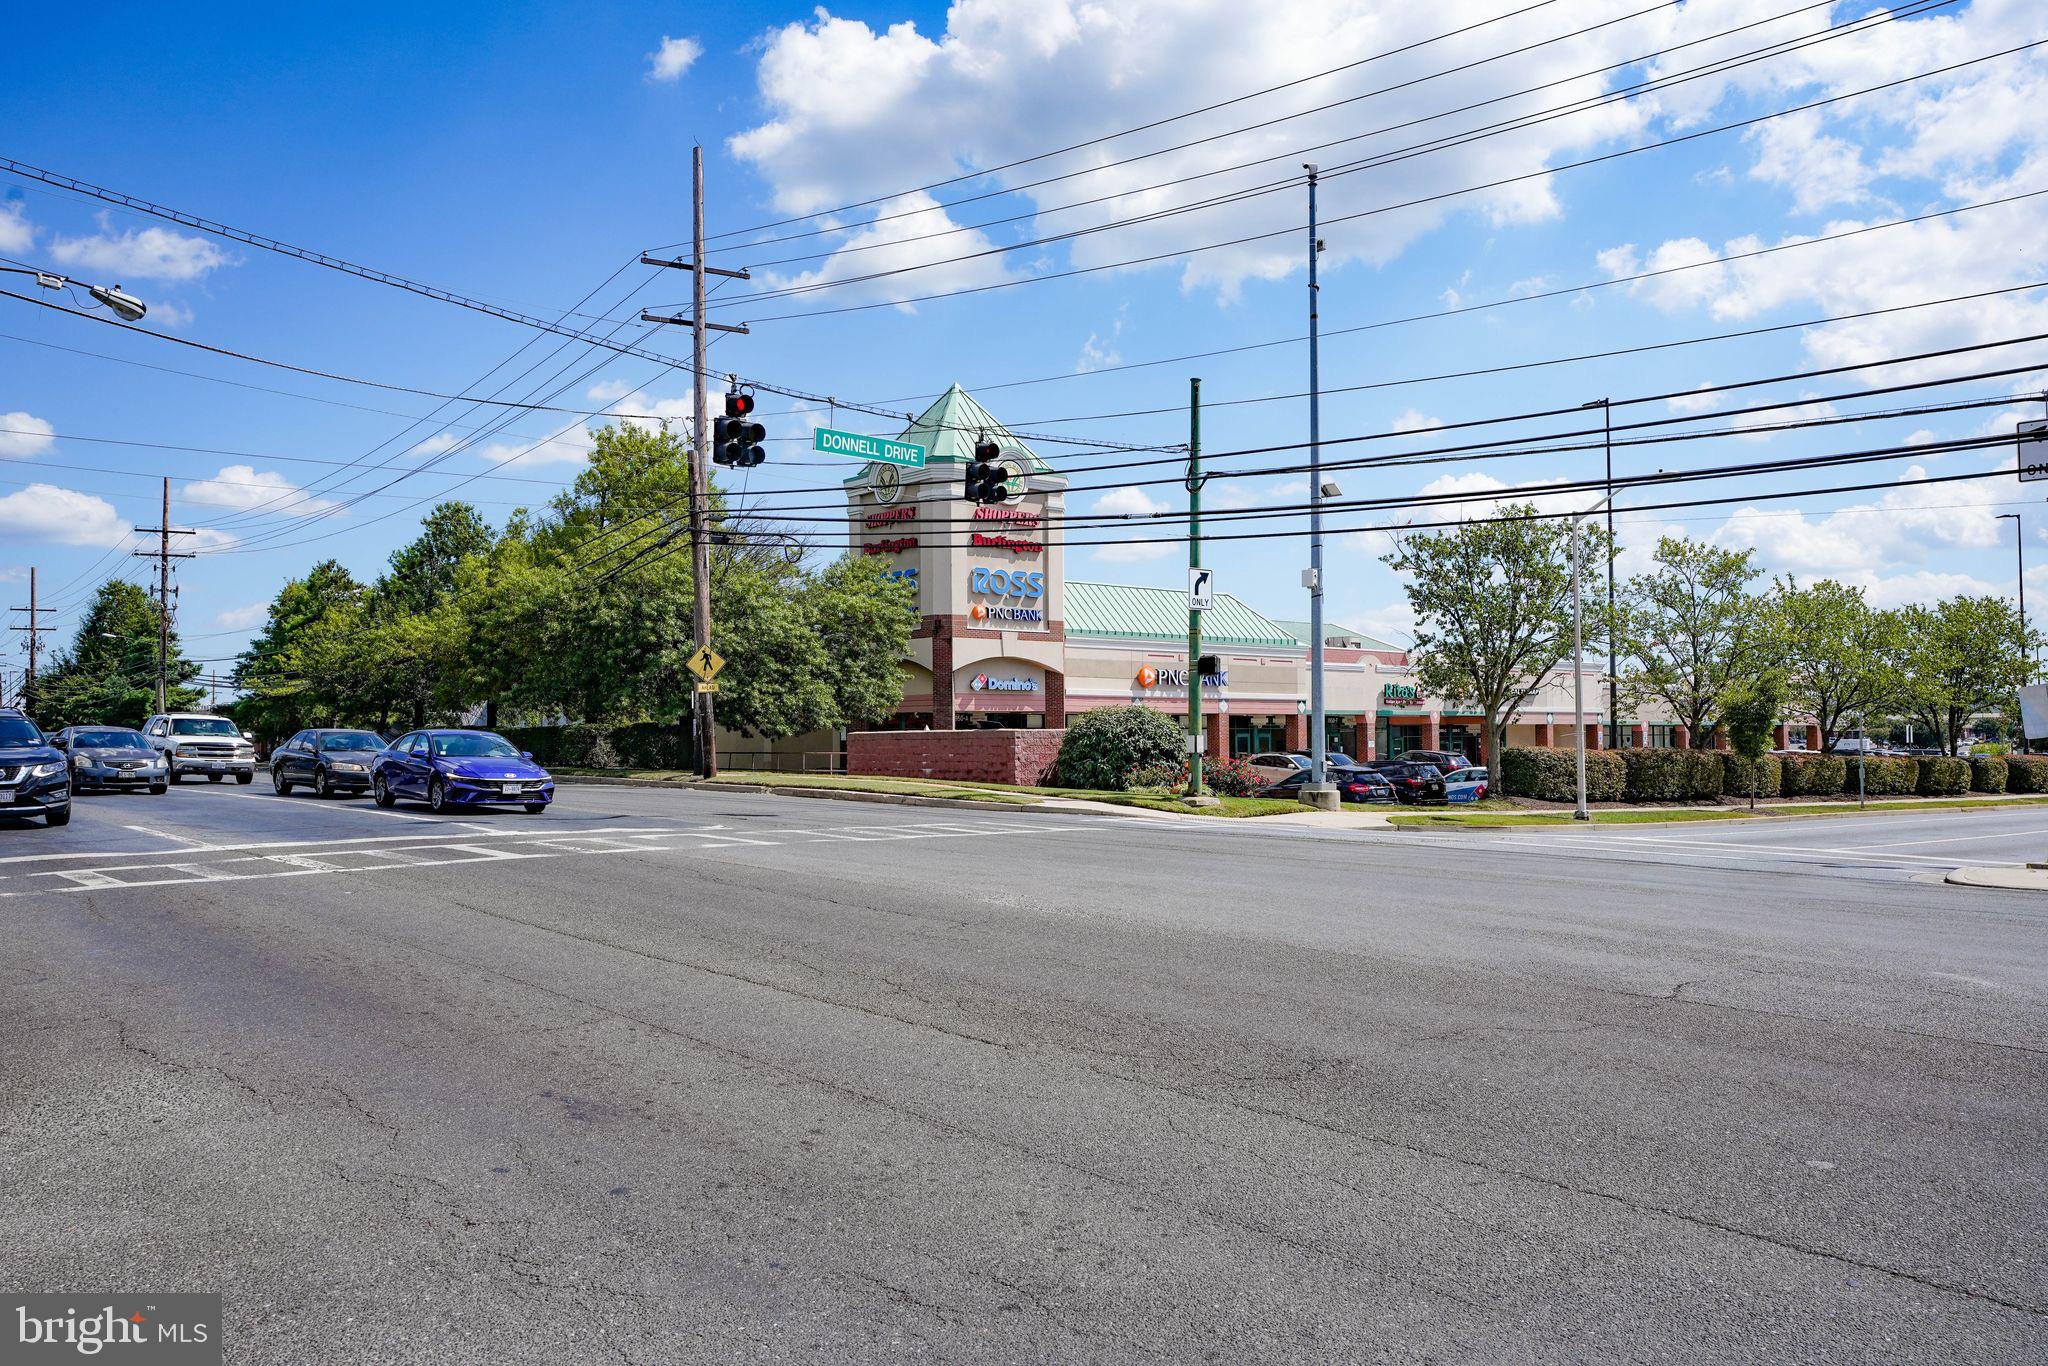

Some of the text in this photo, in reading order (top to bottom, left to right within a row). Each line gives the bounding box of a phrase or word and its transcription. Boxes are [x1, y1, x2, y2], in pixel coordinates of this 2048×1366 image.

[823, 433, 918, 463] DONNELL DRIVE
[972, 567, 1044, 598] ROSS
[1191, 597, 1210, 607] ONLY
[987, 607, 1042, 621] PNC BANK
[988, 677, 1038, 691] Domino's
[1200, 671, 1229, 687] ANK
[1384, 682, 1416, 699] Rita's
